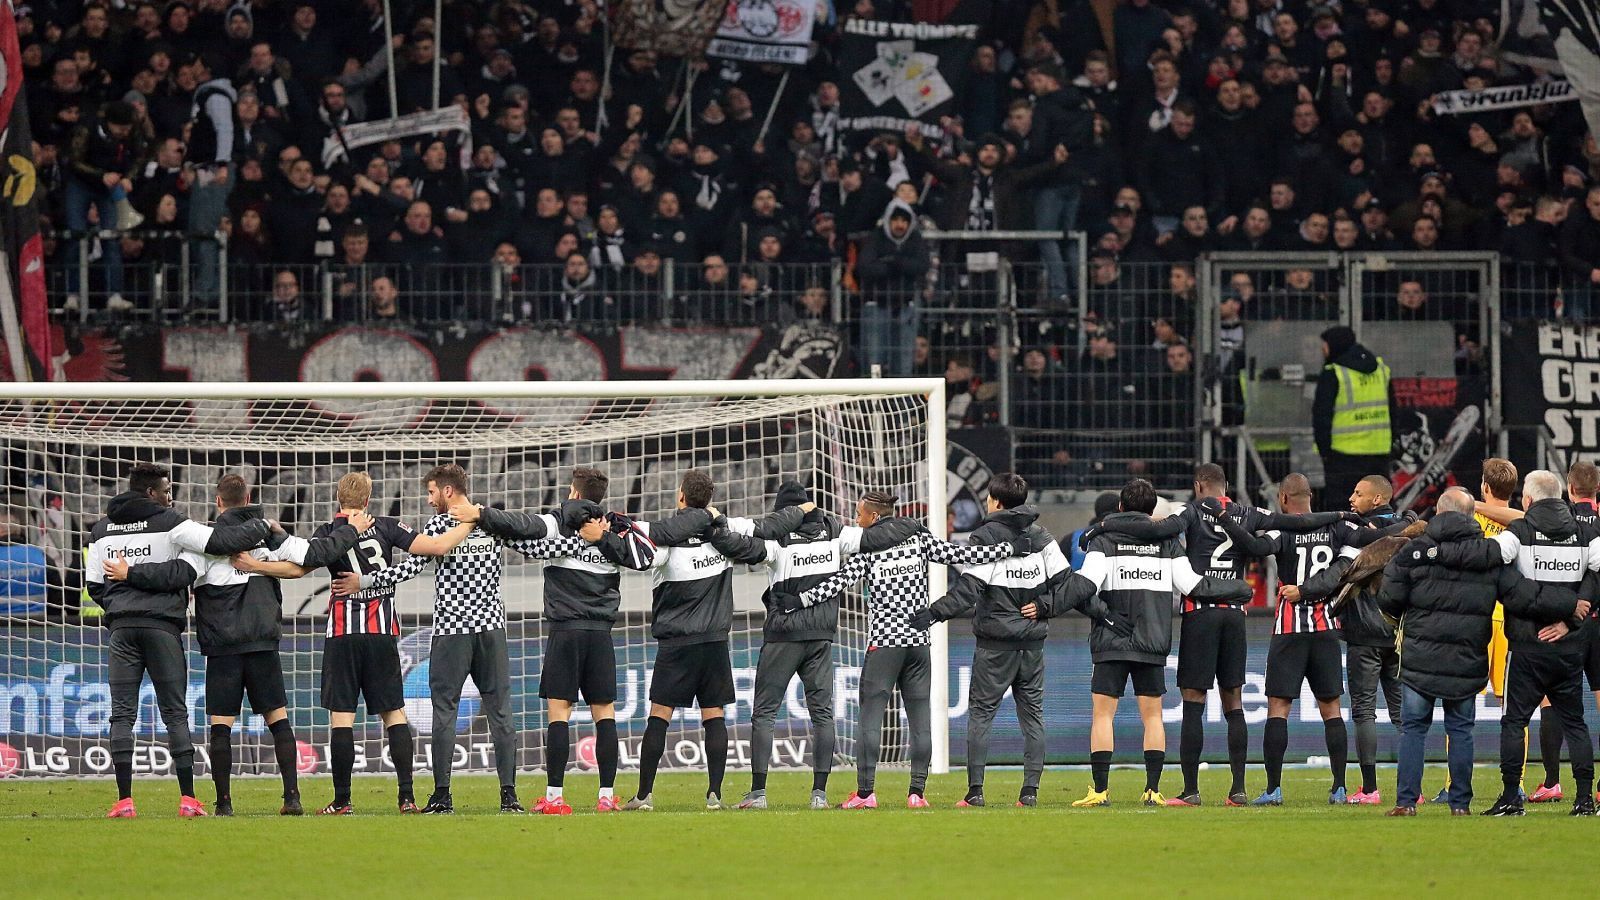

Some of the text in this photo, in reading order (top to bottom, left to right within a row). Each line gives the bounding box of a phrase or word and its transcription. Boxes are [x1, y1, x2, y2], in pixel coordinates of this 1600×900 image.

[845, 18, 889, 37] ALLE
[107, 544, 151, 558] indeed
[1210, 525, 1234, 568] 2
[793, 550, 833, 566] indeed
[1296, 545, 1333, 587] 18
[1534, 558, 1581, 571] indeed
[879, 561, 921, 577] indeed
[1119, 567, 1162, 581] indeed
[26, 746, 70, 771] LG
[84, 745, 173, 771] OED
